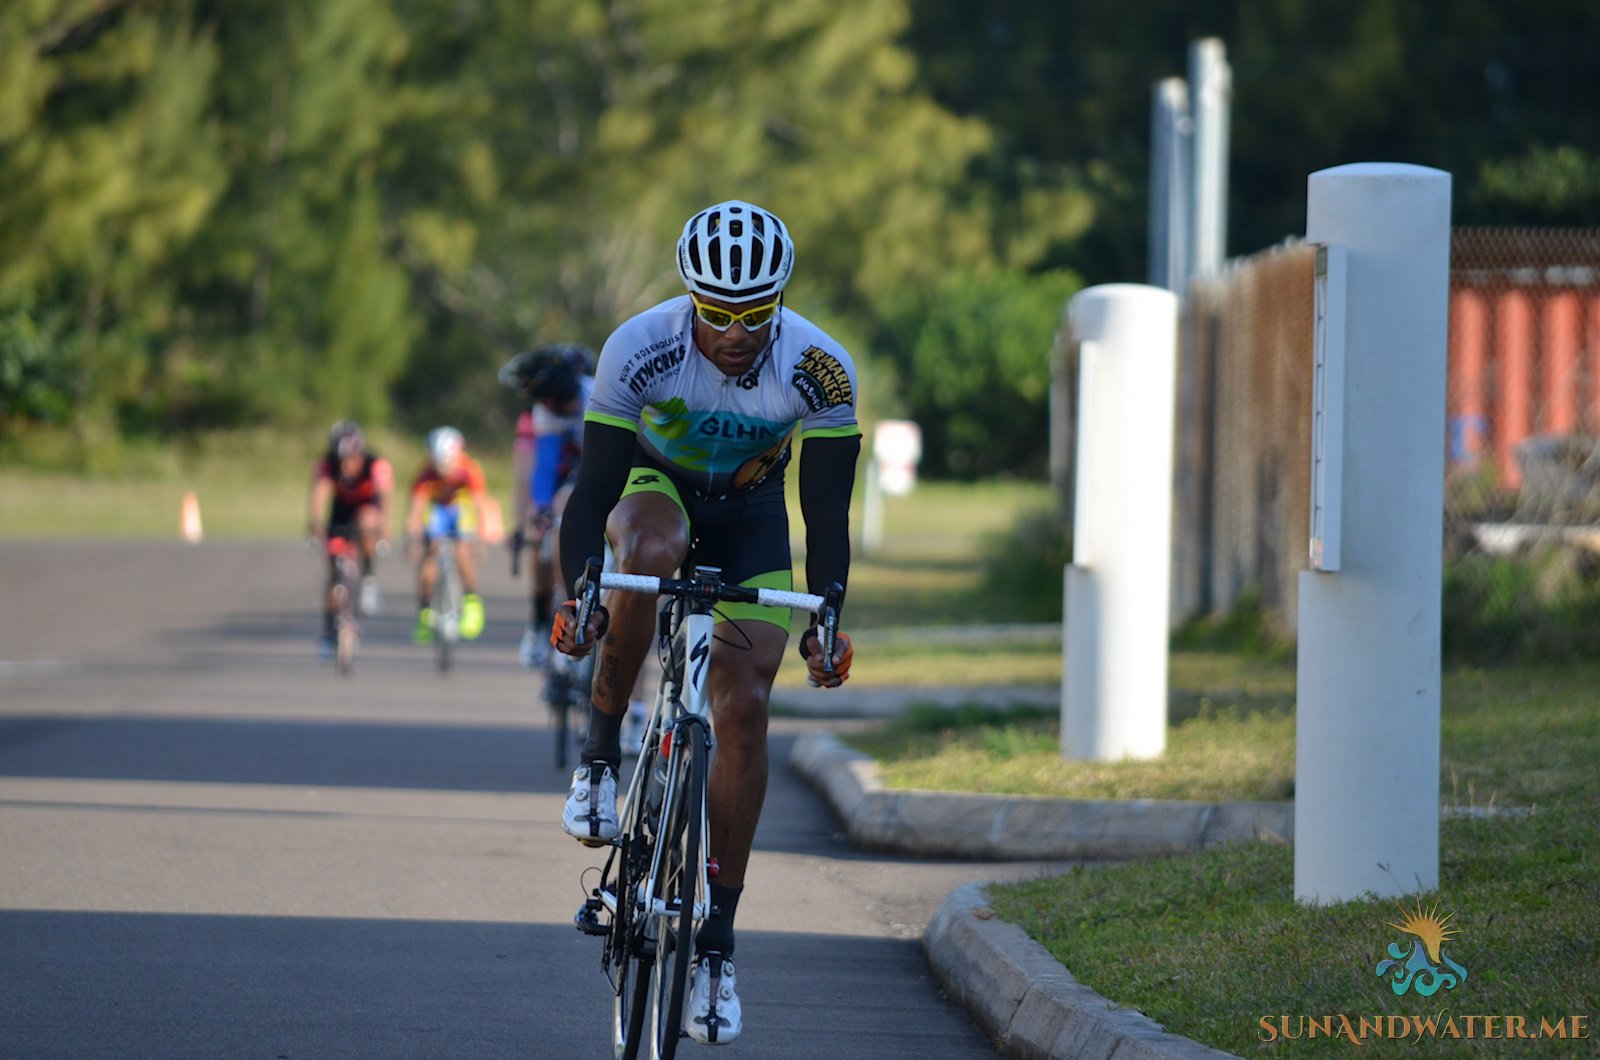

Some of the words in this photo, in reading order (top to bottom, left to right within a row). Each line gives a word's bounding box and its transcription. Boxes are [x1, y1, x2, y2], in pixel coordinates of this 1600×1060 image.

[619, 359, 635, 383] KURT
[634, 331, 684, 361] ROSENQUIST
[796, 356, 842, 407] JAPANESE
[803, 346, 853, 405] PRIMARILY
